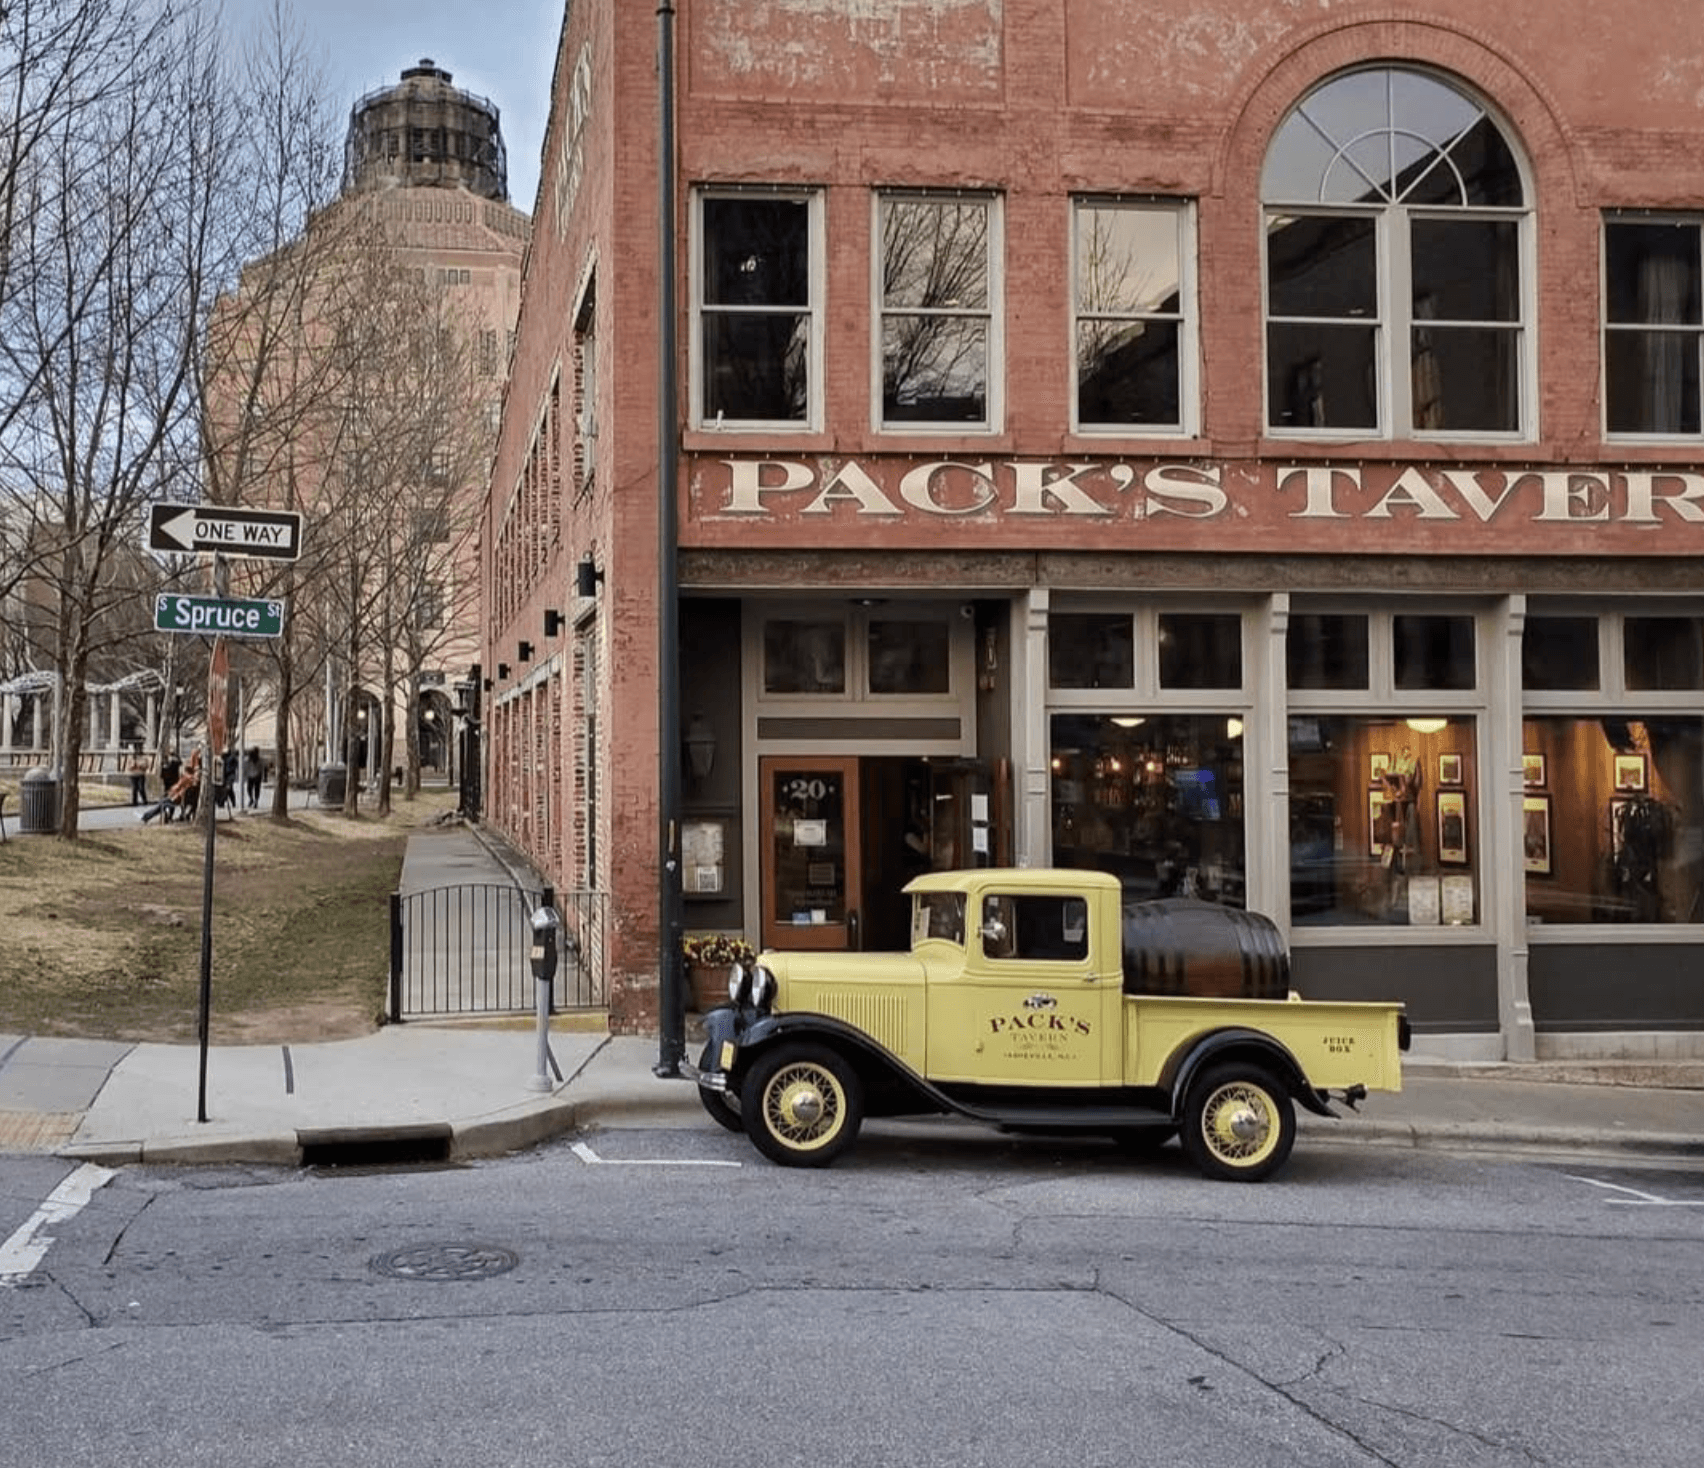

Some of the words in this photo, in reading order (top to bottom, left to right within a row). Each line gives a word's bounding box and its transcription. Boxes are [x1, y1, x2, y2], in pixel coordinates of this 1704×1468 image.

[719, 459, 1228, 518] PACK'S
[195, 521, 235, 540] ONE
[243, 525, 283, 544] WAY
[159, 598, 168, 611] S
[175, 599, 260, 630] Spruce
[267, 603, 280, 618] St
[990, 1014, 1091, 1035] PACK'S
